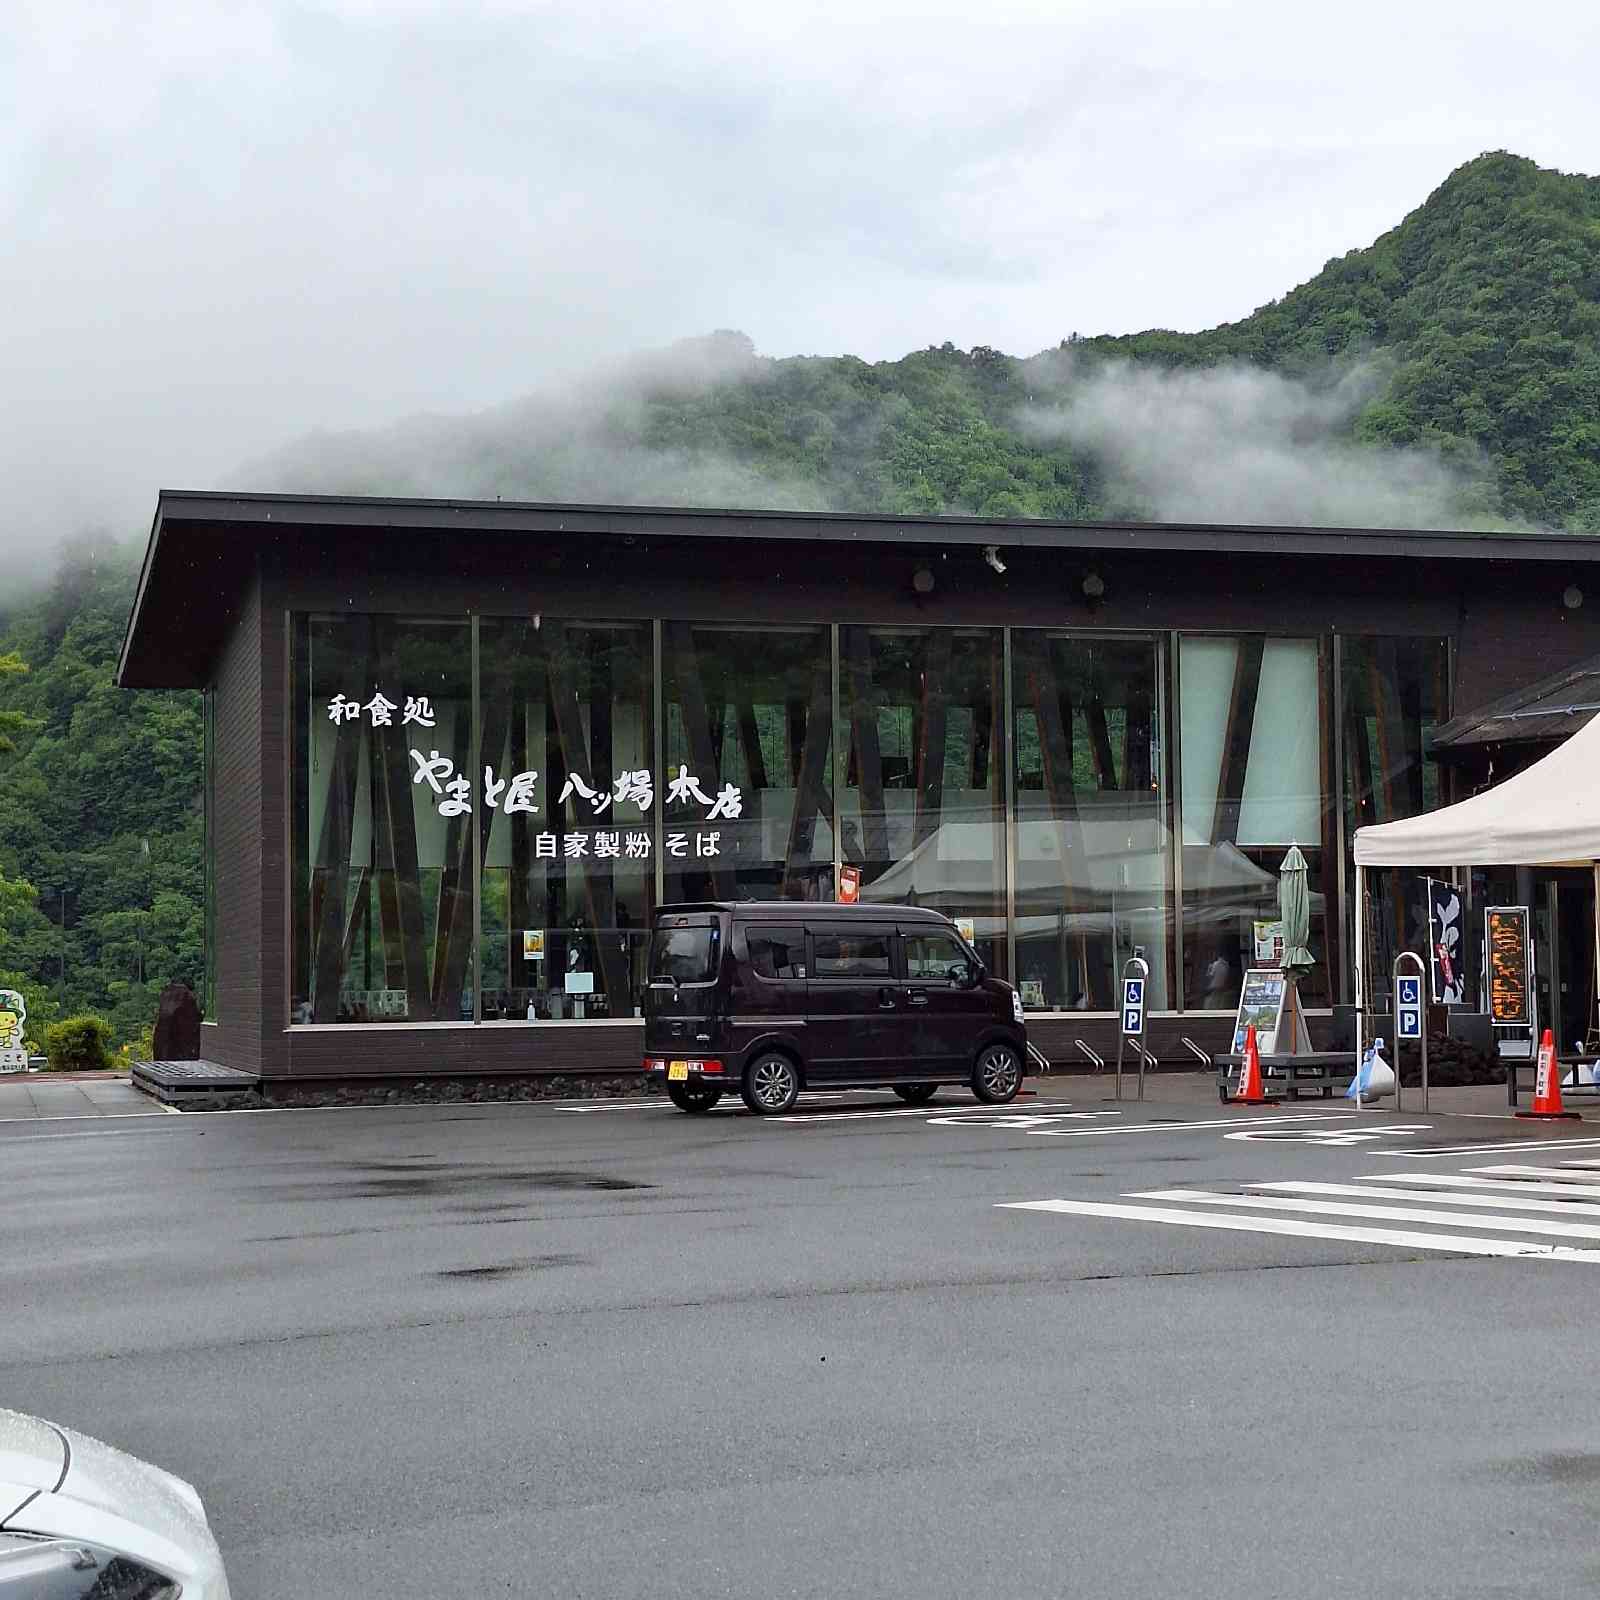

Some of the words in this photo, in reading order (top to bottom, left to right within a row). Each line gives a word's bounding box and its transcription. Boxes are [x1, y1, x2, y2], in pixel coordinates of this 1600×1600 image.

[327, 692, 436, 728] 和食処
[410, 749, 539, 817] やまと屋
[535, 831, 652, 859] 自家製粉
[665, 831, 721, 857] そば
[1127, 1011, 1139, 1029] P
[1404, 1012, 1416, 1032] P
